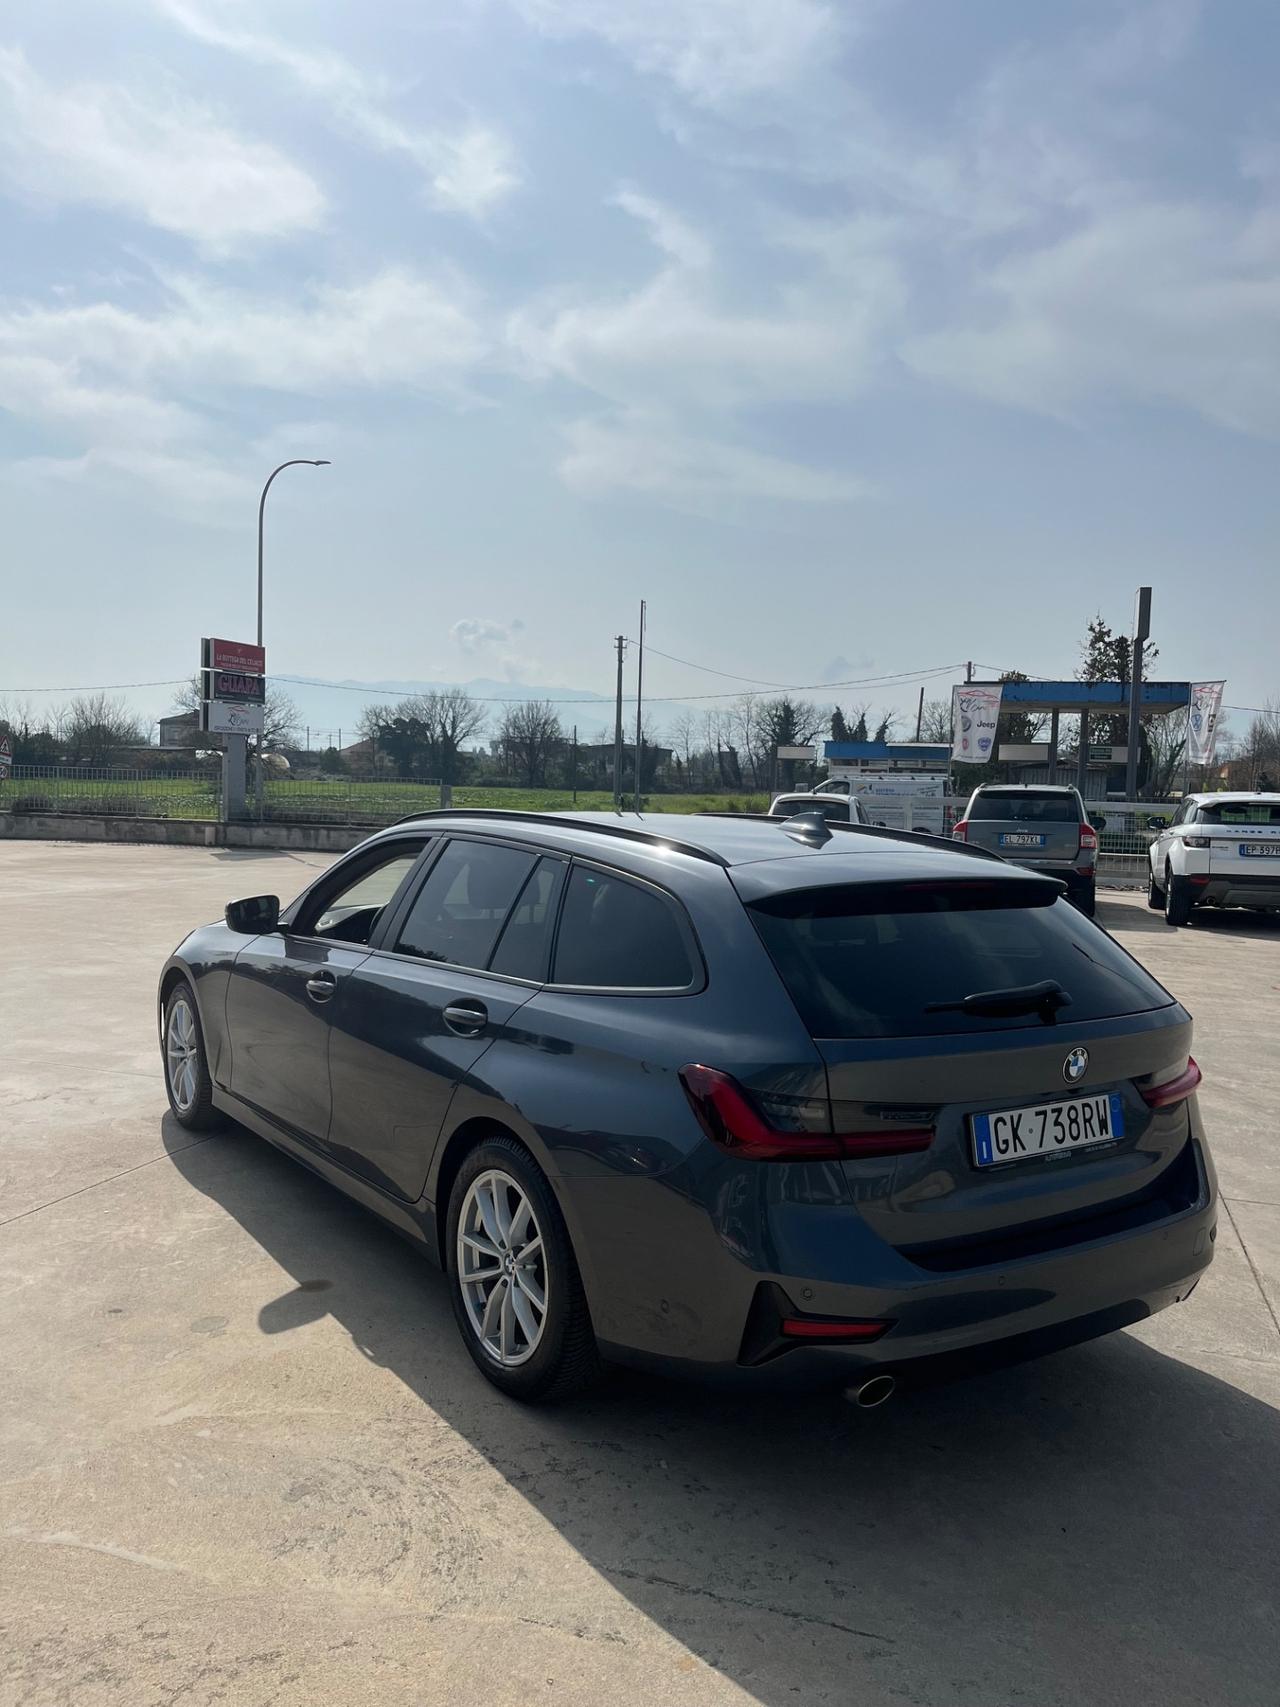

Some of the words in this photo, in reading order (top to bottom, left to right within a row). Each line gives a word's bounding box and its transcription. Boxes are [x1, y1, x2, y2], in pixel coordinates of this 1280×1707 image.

[218, 674, 260, 695] GUAPA
[977, 721, 996, 729] Jeep
[1004, 835, 1013, 843] EL
[1016, 835, 1039, 844] 797KL
[1246, 846, 1257, 854] EP
[993, 1113, 1026, 1155] GK
[1034, 1099, 1109, 1149] 738RW
